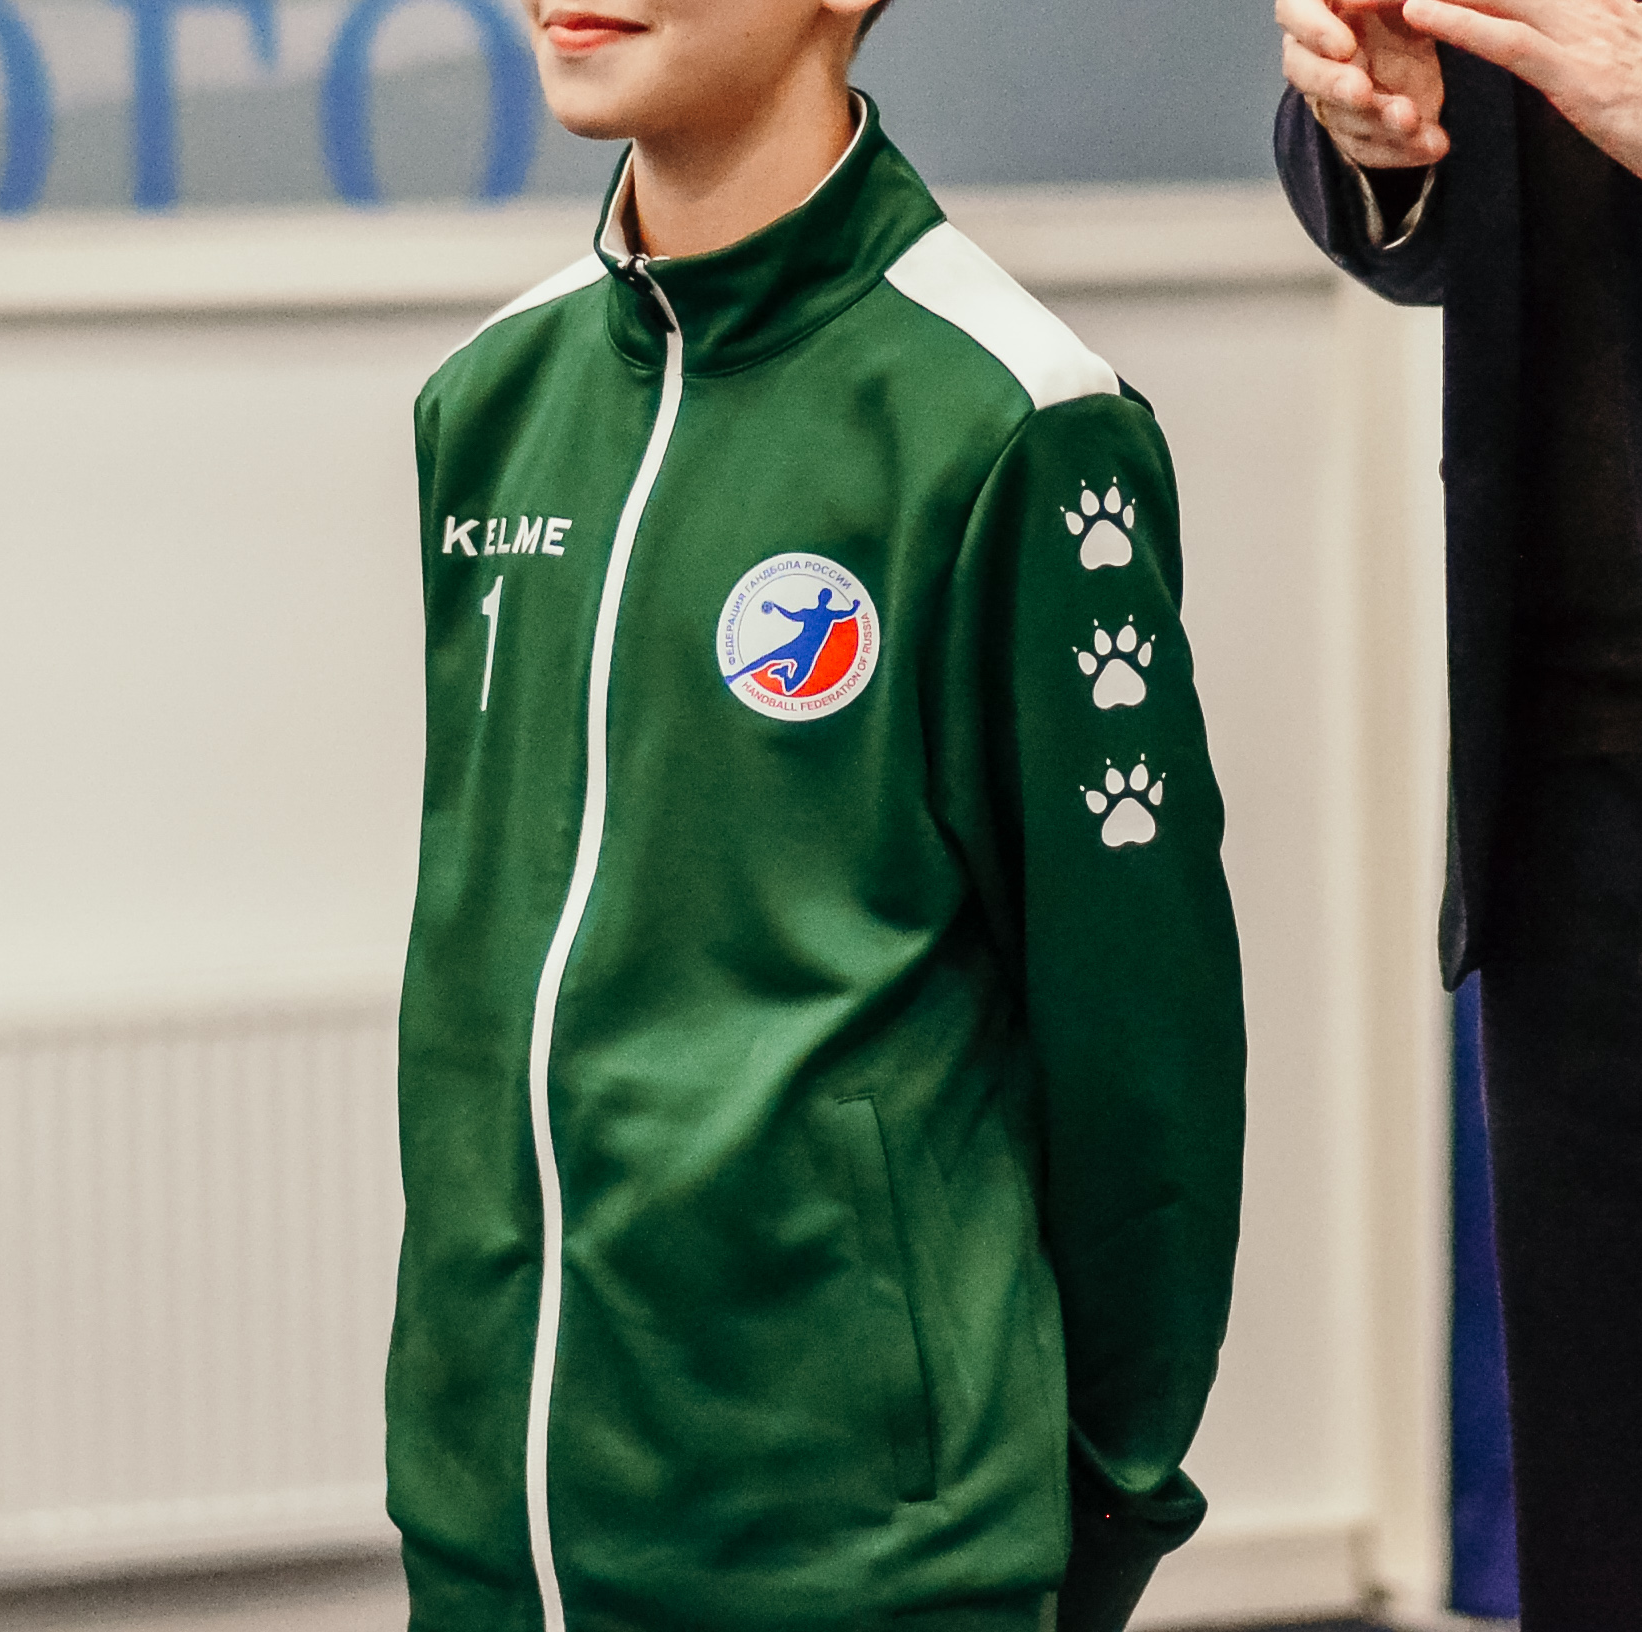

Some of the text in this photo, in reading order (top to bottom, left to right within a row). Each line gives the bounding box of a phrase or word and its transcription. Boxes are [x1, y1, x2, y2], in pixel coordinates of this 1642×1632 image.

[442, 515, 573, 556] KELME
[481, 575, 504, 711] 1
[725, 560, 853, 666] ФЕДЕРАЦИЯ ГАНДБОЛА РОССИИ
[741, 612, 873, 712] HANDBALL FEDERATION OF RUSSIA
